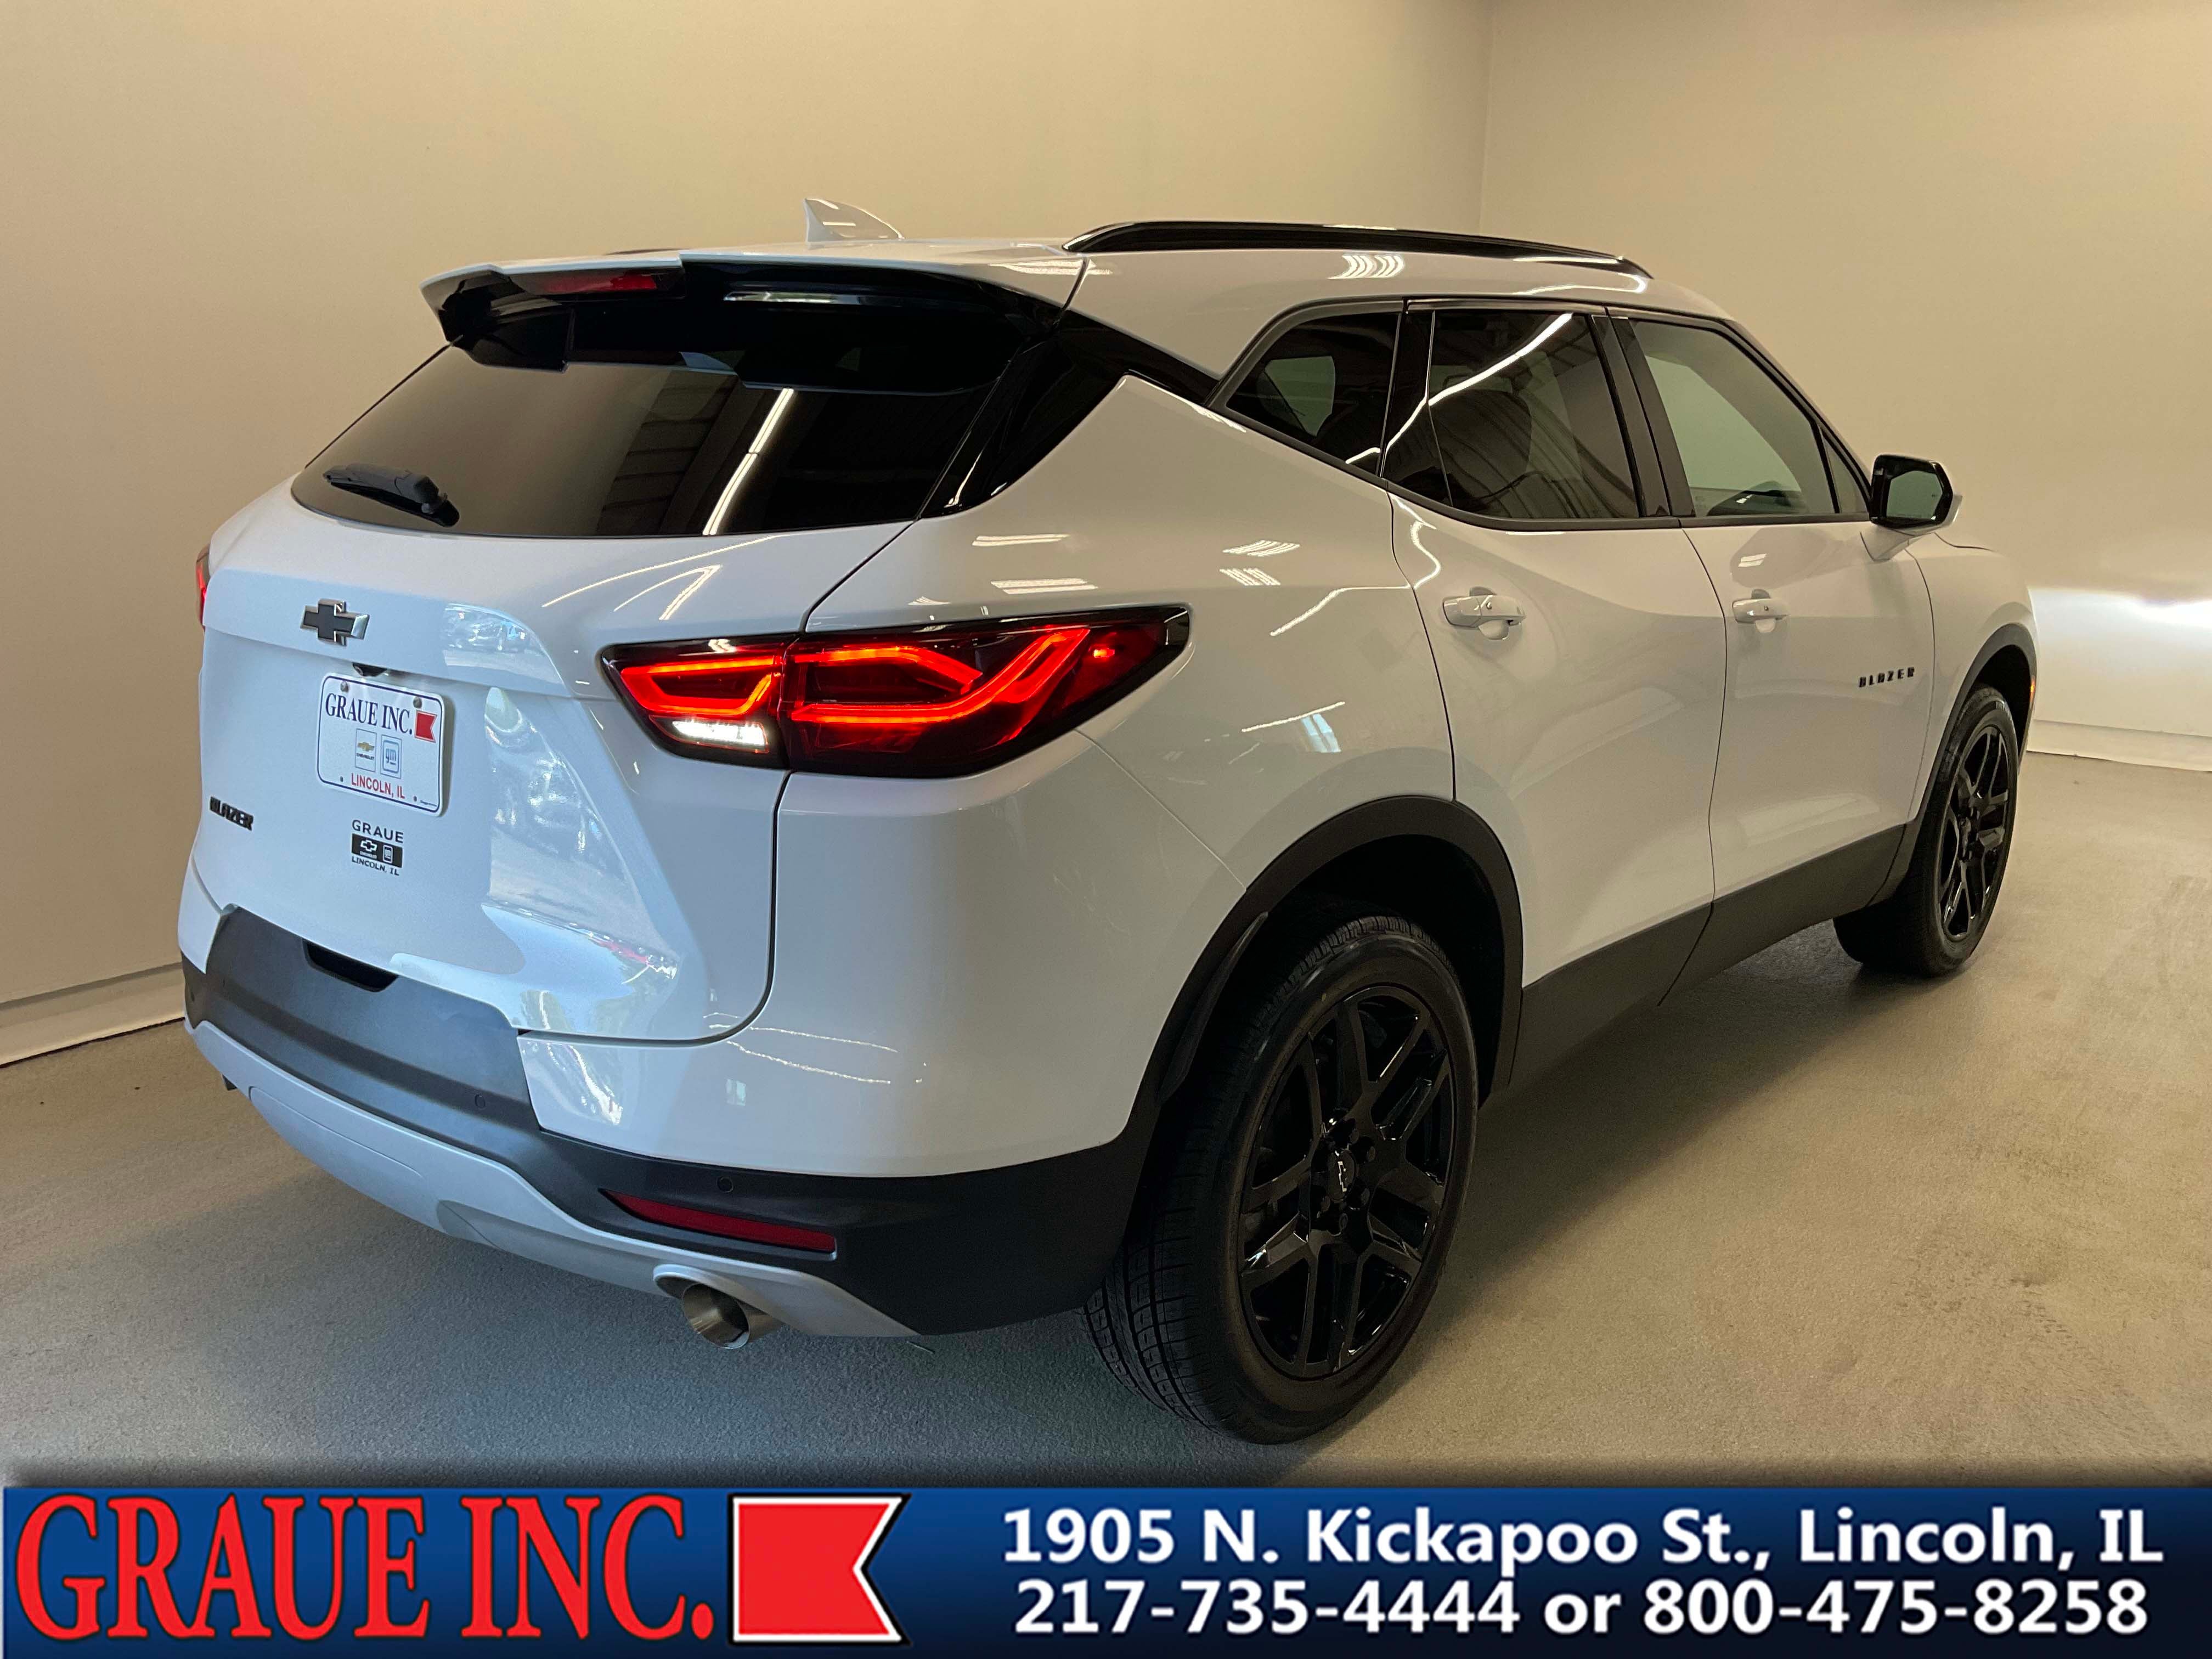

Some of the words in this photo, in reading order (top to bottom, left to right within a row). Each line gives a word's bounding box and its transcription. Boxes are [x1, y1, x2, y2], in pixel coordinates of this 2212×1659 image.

[1859, 667, 1915, 688] BLAZER
[325, 693, 379, 726] GRAUE
[382, 704, 413, 735] INC.
[351, 772, 394, 798] LINCOLN,
[397, 785, 405, 799] IL
[210, 796, 254, 831] BLAZER
[352, 819, 404, 844] GRAUE
[390, 867, 400, 877] IL
